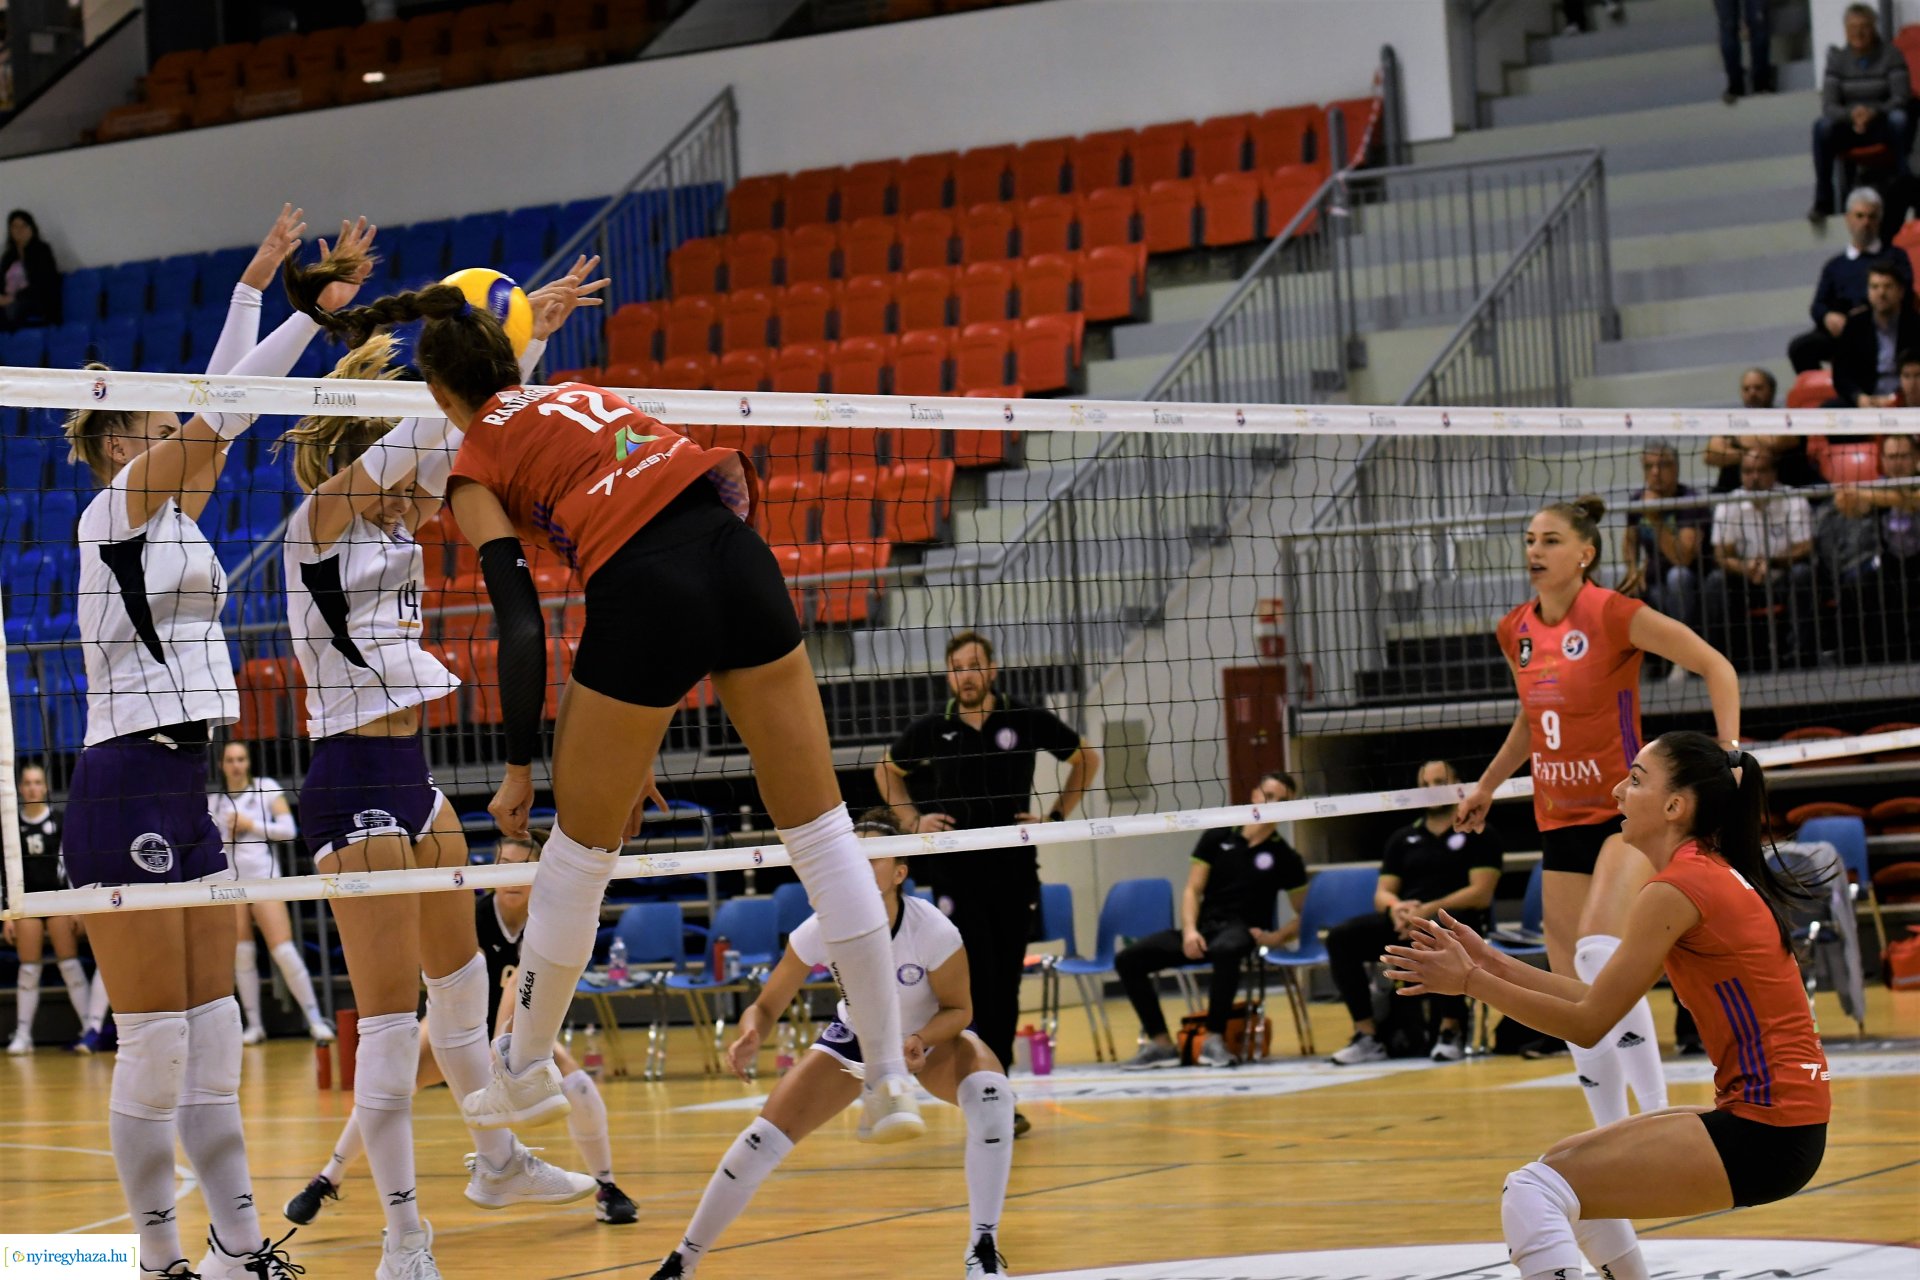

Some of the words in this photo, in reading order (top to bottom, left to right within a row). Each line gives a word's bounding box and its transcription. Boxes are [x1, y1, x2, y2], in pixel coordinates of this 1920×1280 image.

[313, 386, 356, 405] FATUM
[538, 390, 634, 433] 12
[910, 403, 944, 420] FATUM
[398, 580, 418, 620] 14
[1541, 710, 1561, 750] 9
[1532, 752, 1601, 780] FATUM
[210, 885, 247, 900] FATUM
